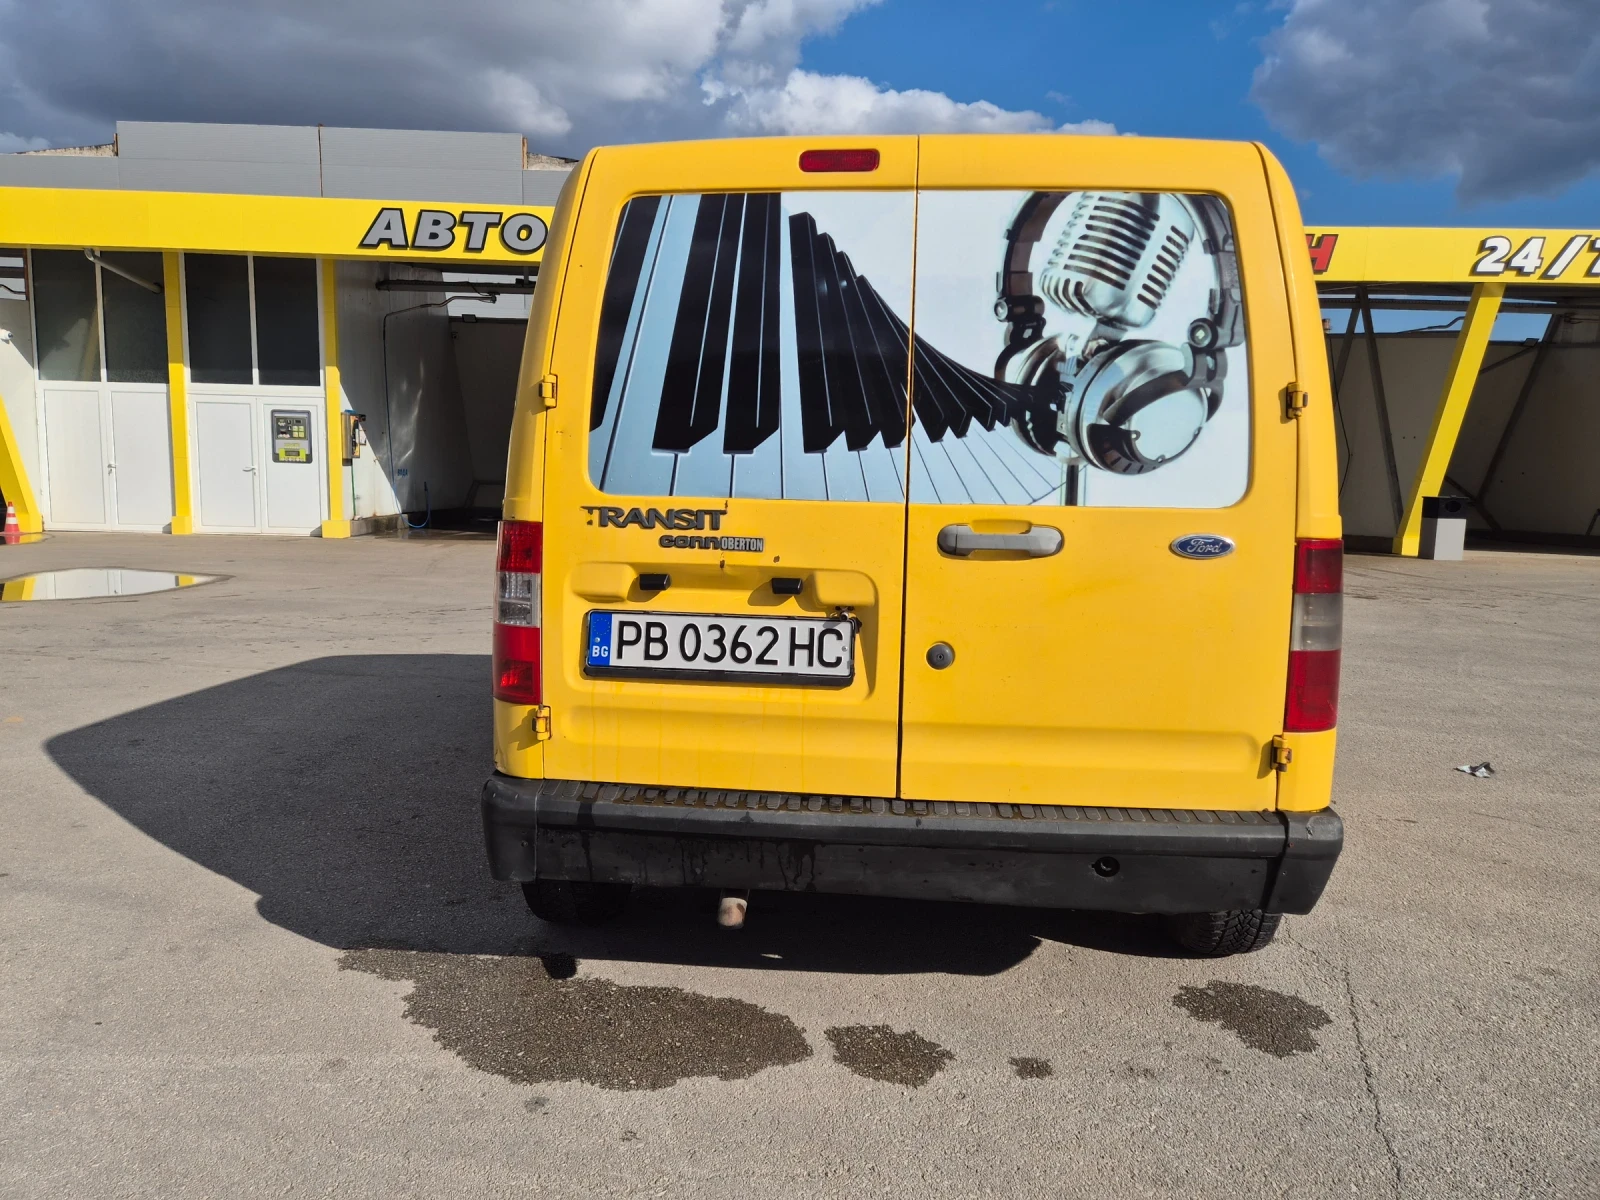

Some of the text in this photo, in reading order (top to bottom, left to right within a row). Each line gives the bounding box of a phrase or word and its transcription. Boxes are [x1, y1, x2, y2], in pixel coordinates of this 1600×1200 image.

[580, 505, 728, 530] TRANSIT
[720, 536, 764, 552] OBERTON
[1187, 538, 1222, 553] Ford
[592, 645, 609, 658] BG
[679, 623, 780, 666] 0362
